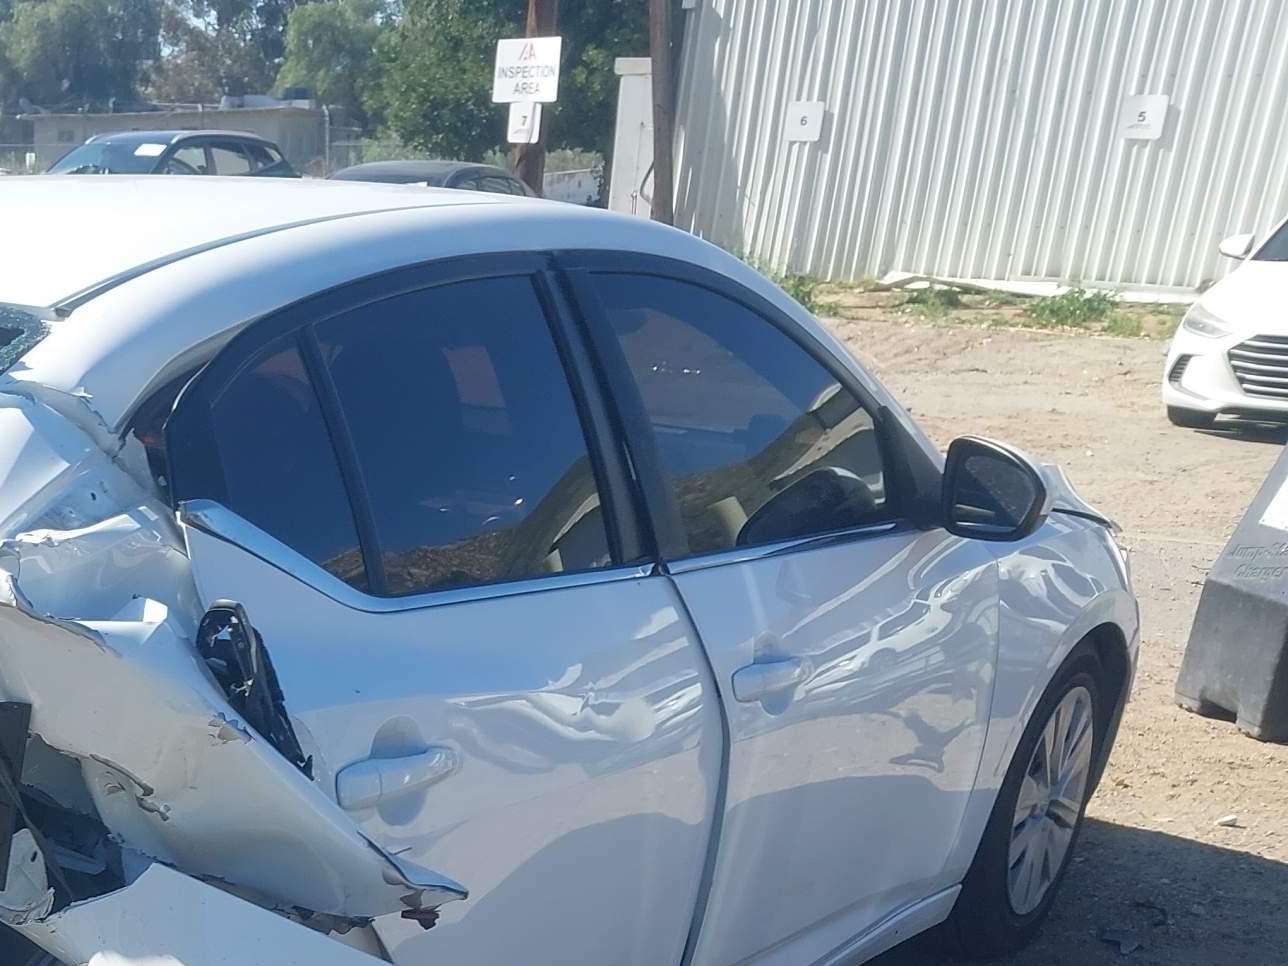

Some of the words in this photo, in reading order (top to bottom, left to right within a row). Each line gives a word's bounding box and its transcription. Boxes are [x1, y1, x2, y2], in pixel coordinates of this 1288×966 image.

[497, 65, 555, 79] INSPECTION
[513, 83, 540, 94] AREA
[521, 115, 528, 126] 7
[800, 116, 808, 126] 6
[1136, 111, 1147, 122] 5
